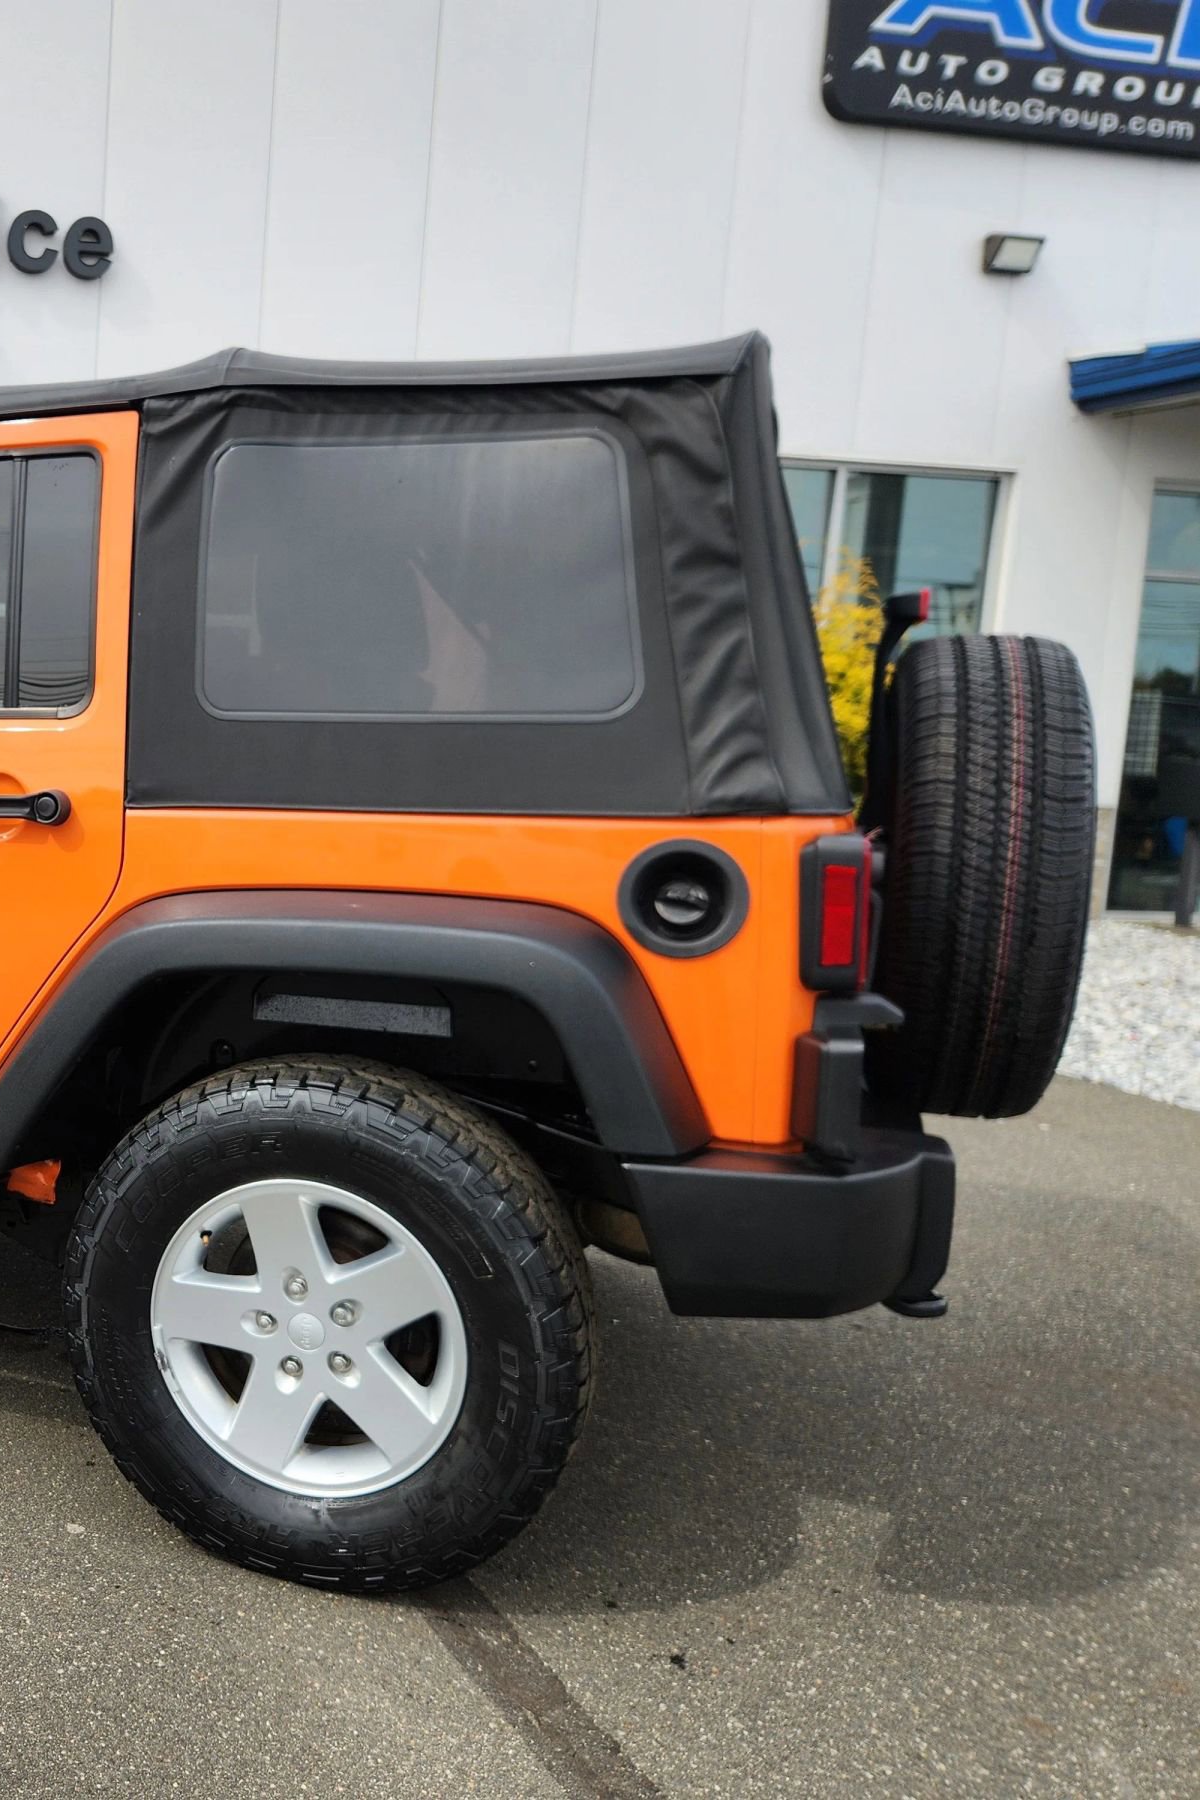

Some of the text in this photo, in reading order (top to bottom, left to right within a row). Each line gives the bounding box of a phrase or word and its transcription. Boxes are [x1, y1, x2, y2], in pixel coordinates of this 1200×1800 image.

[852, 46, 1200, 109] AUTO GROU
[889, 83, 1195, 141] AciAutoGroup.com
